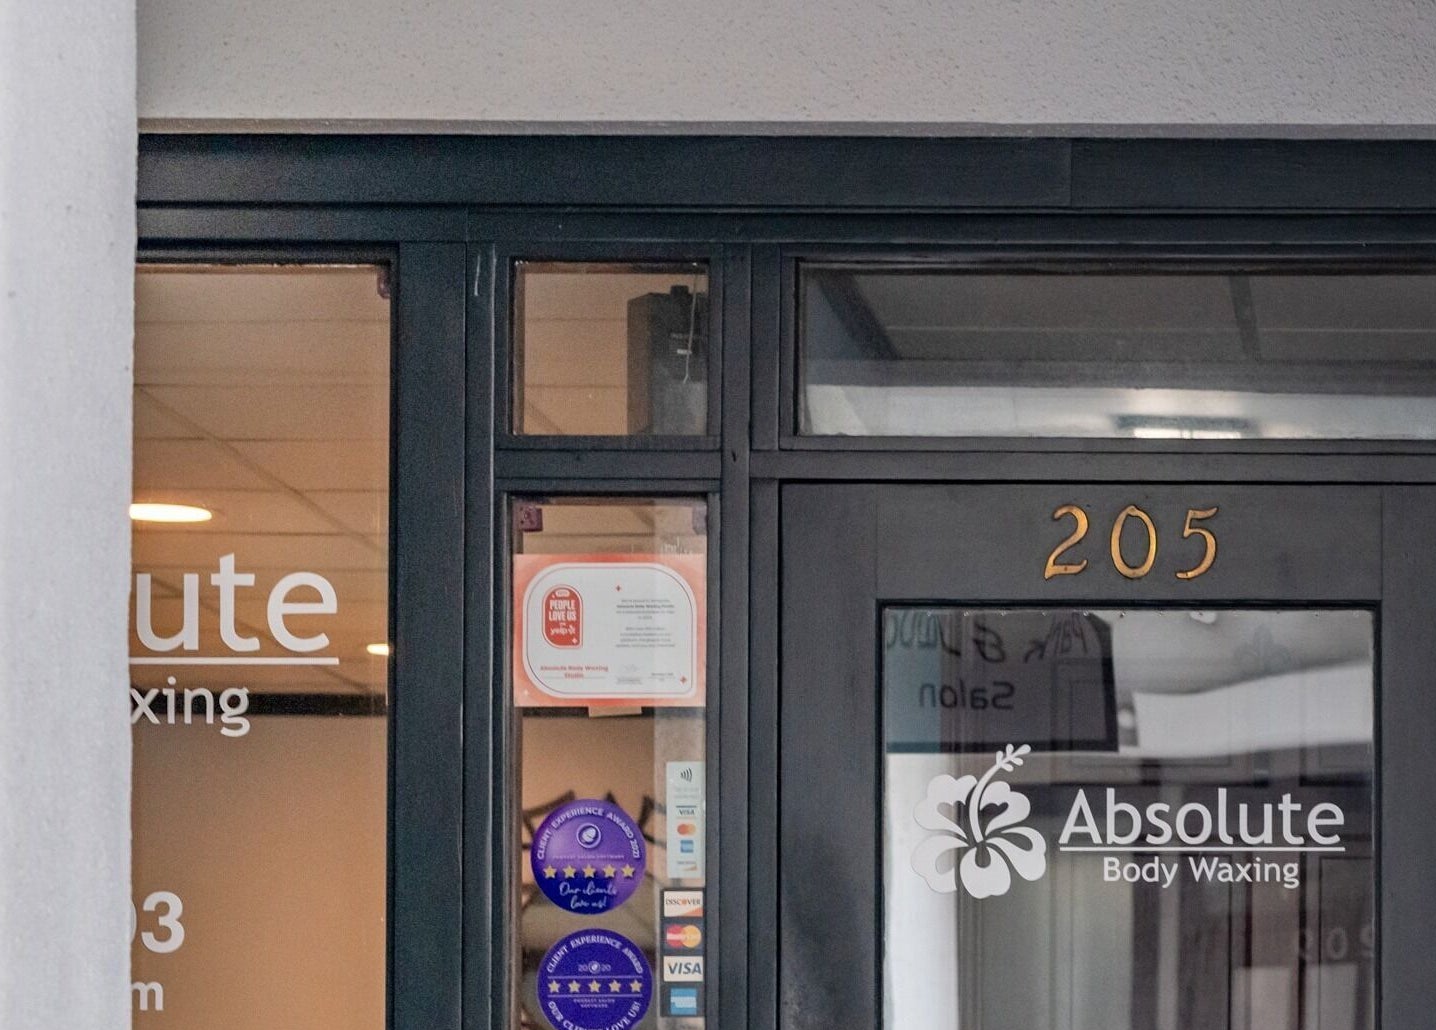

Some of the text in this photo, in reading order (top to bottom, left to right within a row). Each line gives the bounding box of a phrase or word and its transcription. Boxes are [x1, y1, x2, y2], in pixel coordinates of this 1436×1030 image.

[1044, 504, 1219, 580] 205
[548, 610, 577, 622] LOVE US
[550, 599, 576, 610] PEOPLE
[1058, 787, 1345, 845] Absolute
[537, 829, 552, 859] CLIENT
[551, 807, 604, 828] EXPERIENCE
[606, 812, 634, 838] AWARD
[559, 881, 581, 896] Our
[1103, 856, 1300, 889] Body Waxing
[131, 890, 185, 954] 3
[547, 935, 643, 974] CLIENT EXPERIENCE AWARD
[668, 962, 702, 975] VISA
[548, 1001, 564, 1022] OUR
